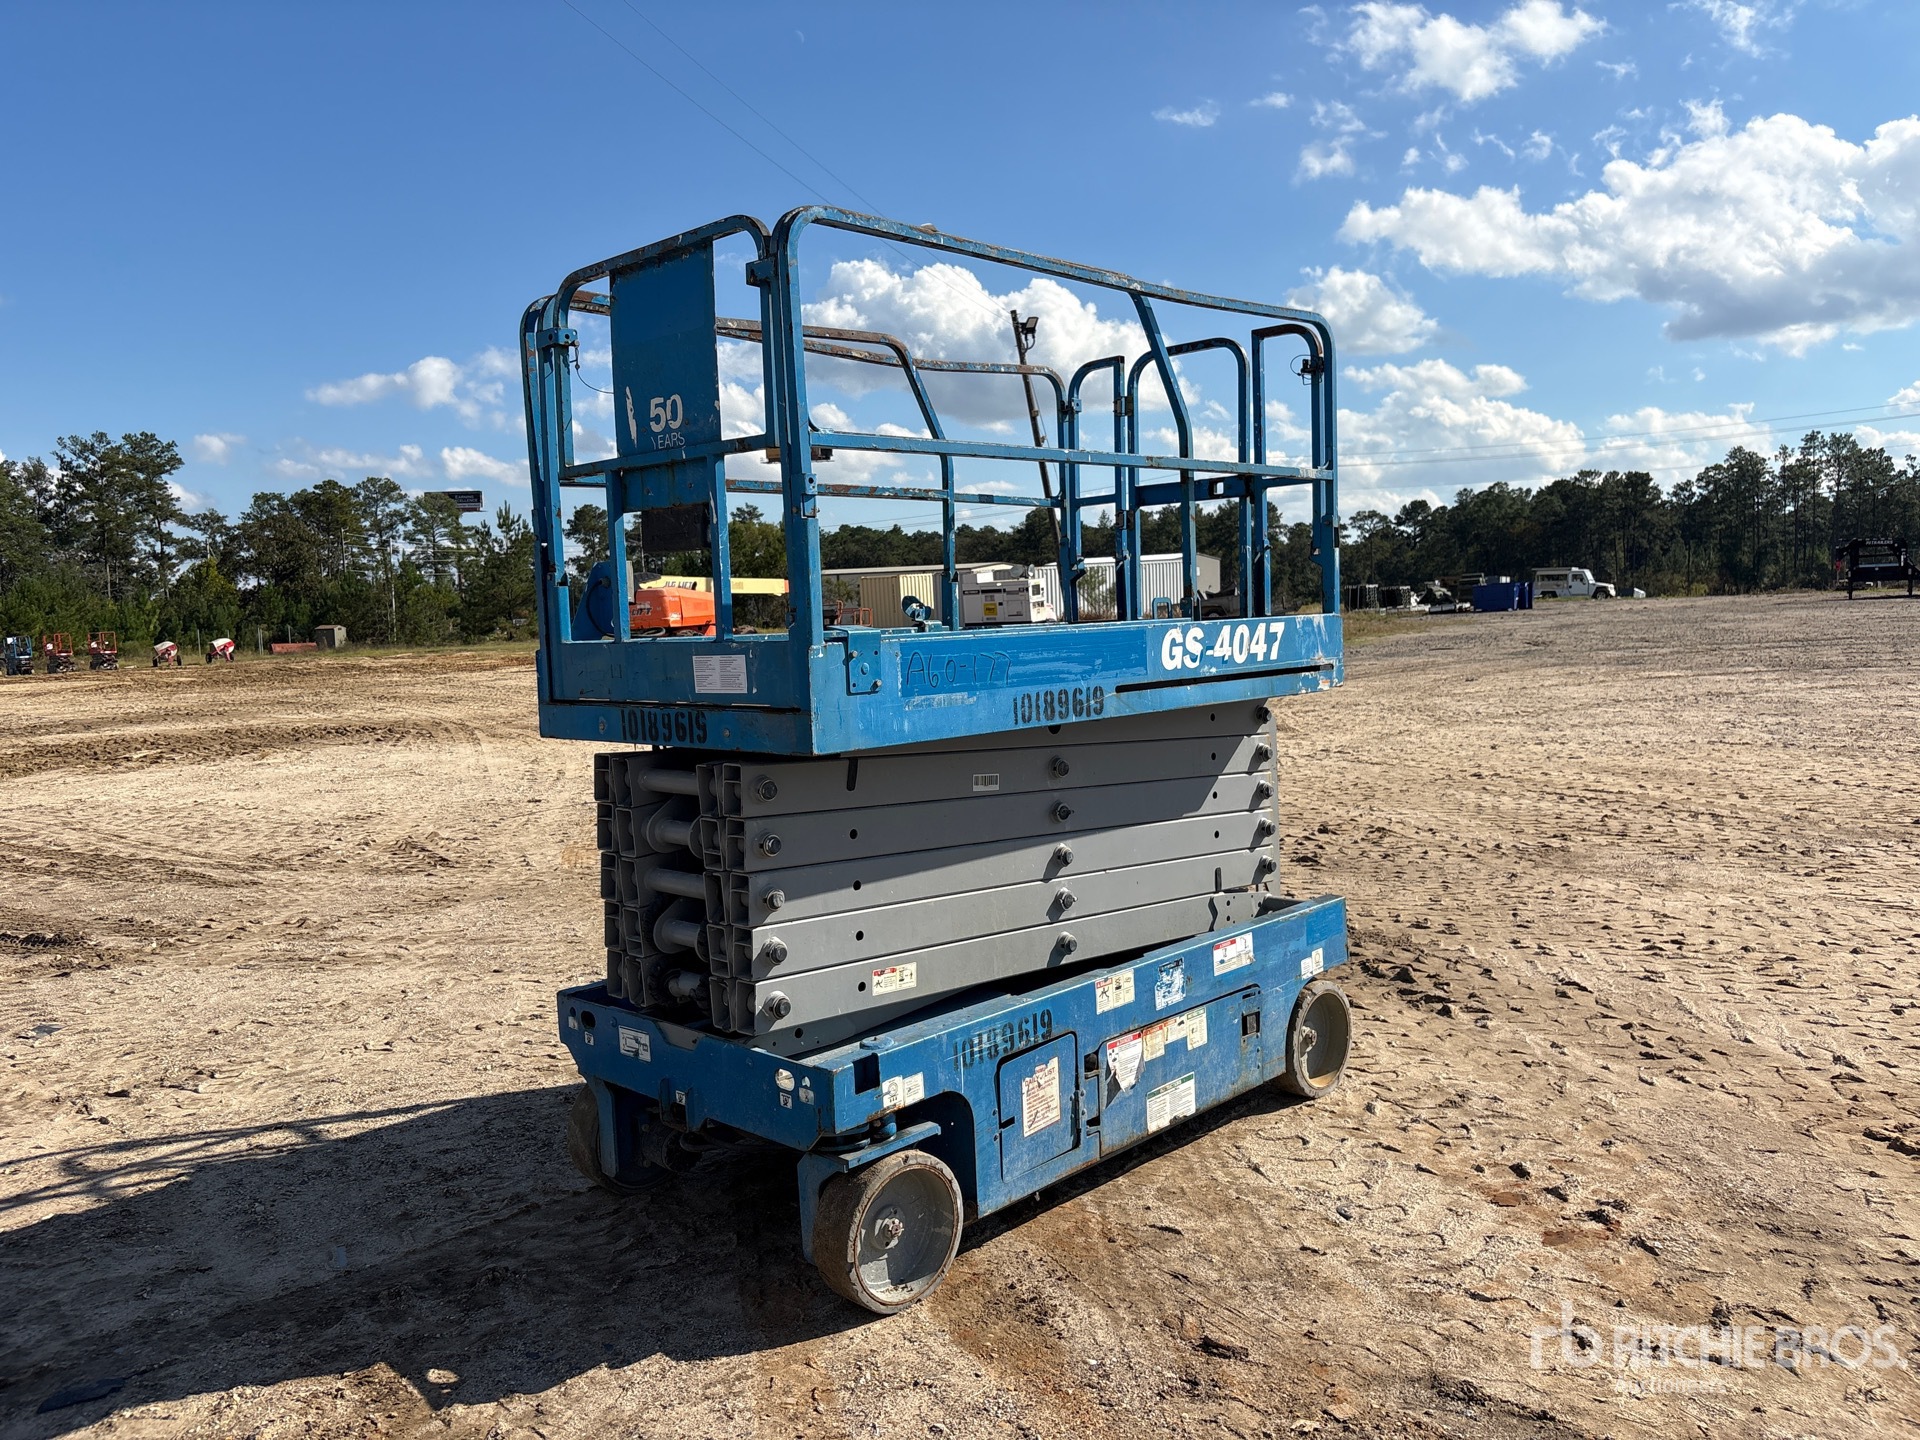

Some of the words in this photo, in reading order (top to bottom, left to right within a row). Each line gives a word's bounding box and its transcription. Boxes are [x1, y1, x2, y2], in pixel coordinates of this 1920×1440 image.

[650, 394, 683, 432] 50
[651, 432, 685, 449] YEARS
[1161, 622, 1285, 671] GS-4047
[1013, 685, 1105, 725] 10189619
[953, 1008, 1053, 1072] 10189619
[1044, 1066, 1056, 1077] LIST
